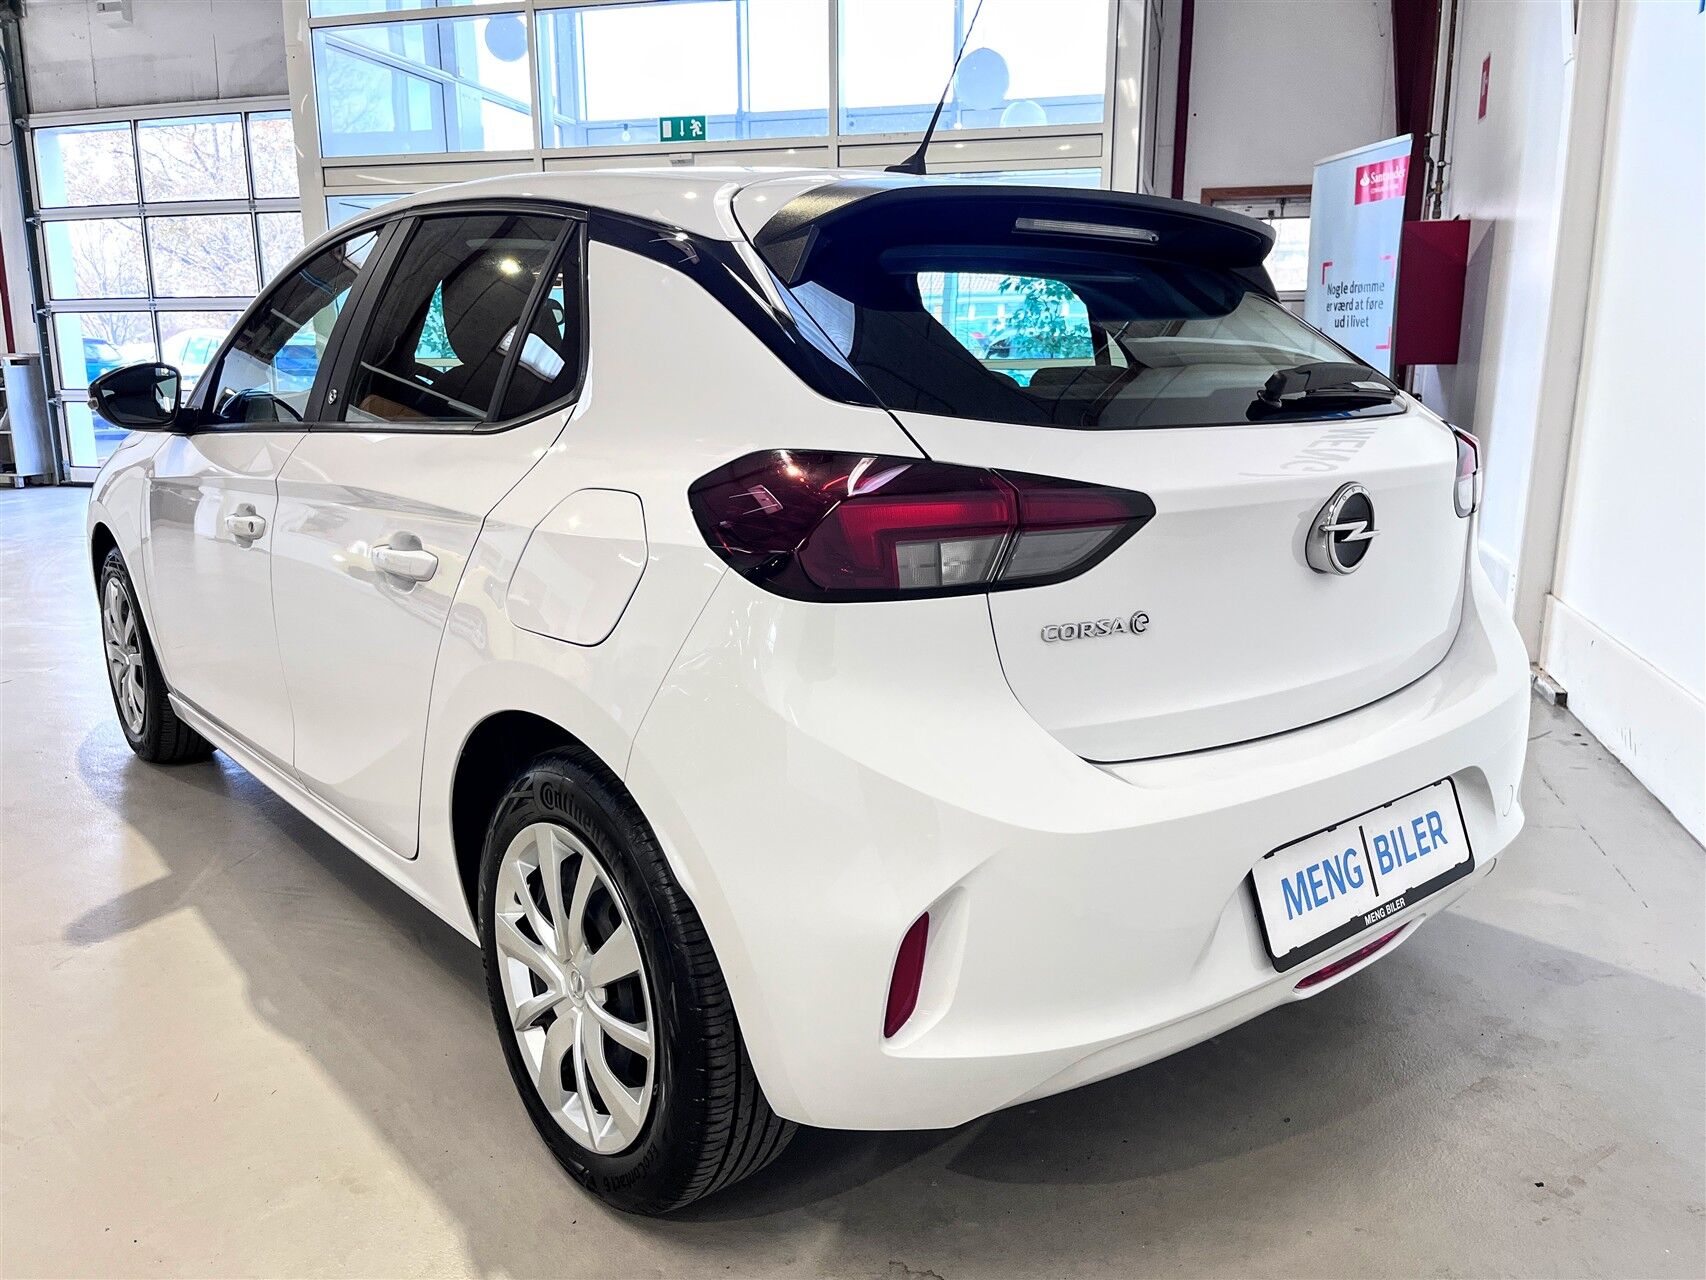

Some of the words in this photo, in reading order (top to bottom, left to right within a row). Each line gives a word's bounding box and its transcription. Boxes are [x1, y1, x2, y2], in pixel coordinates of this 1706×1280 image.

[1327, 281, 1349, 298] Nogle
[1350, 280, 1385, 294] drømme
[1326, 302, 1333, 312] er
[1334, 298, 1354, 311] værd
[1355, 299, 1364, 310] at
[1365, 297, 1384, 310] føre
[1334, 315, 1345, 328] ud
[1350, 314, 1369, 328] livet
[1040, 616, 1128, 642] CORSA
[1281, 847, 1365, 920] MENG
[1373, 810, 1449, 876] BILER
[1364, 907, 1386, 926] MENG
[1386, 897, 1406, 916] BILER
